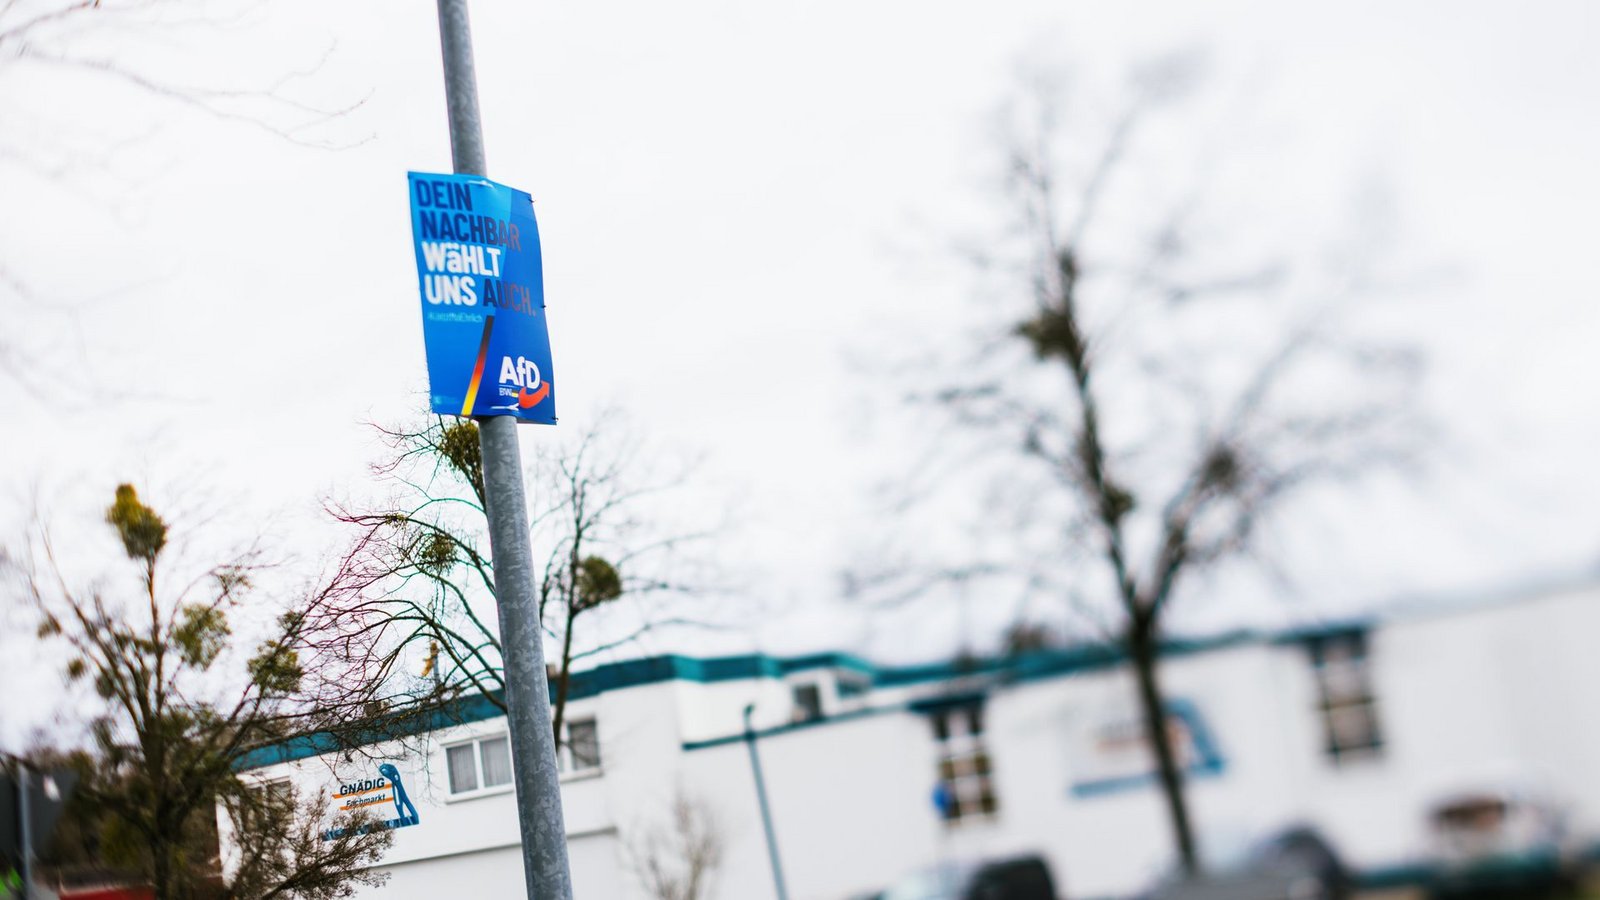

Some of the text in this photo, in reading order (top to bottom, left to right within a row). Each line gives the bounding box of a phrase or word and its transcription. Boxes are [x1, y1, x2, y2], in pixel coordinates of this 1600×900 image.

[416, 181, 472, 211] DEIN
[421, 211, 520, 251] NACHBAR
[424, 274, 536, 316] UNS AUCH.
[499, 355, 541, 389] AfD
[340, 778, 385, 795] GNÄDIG
